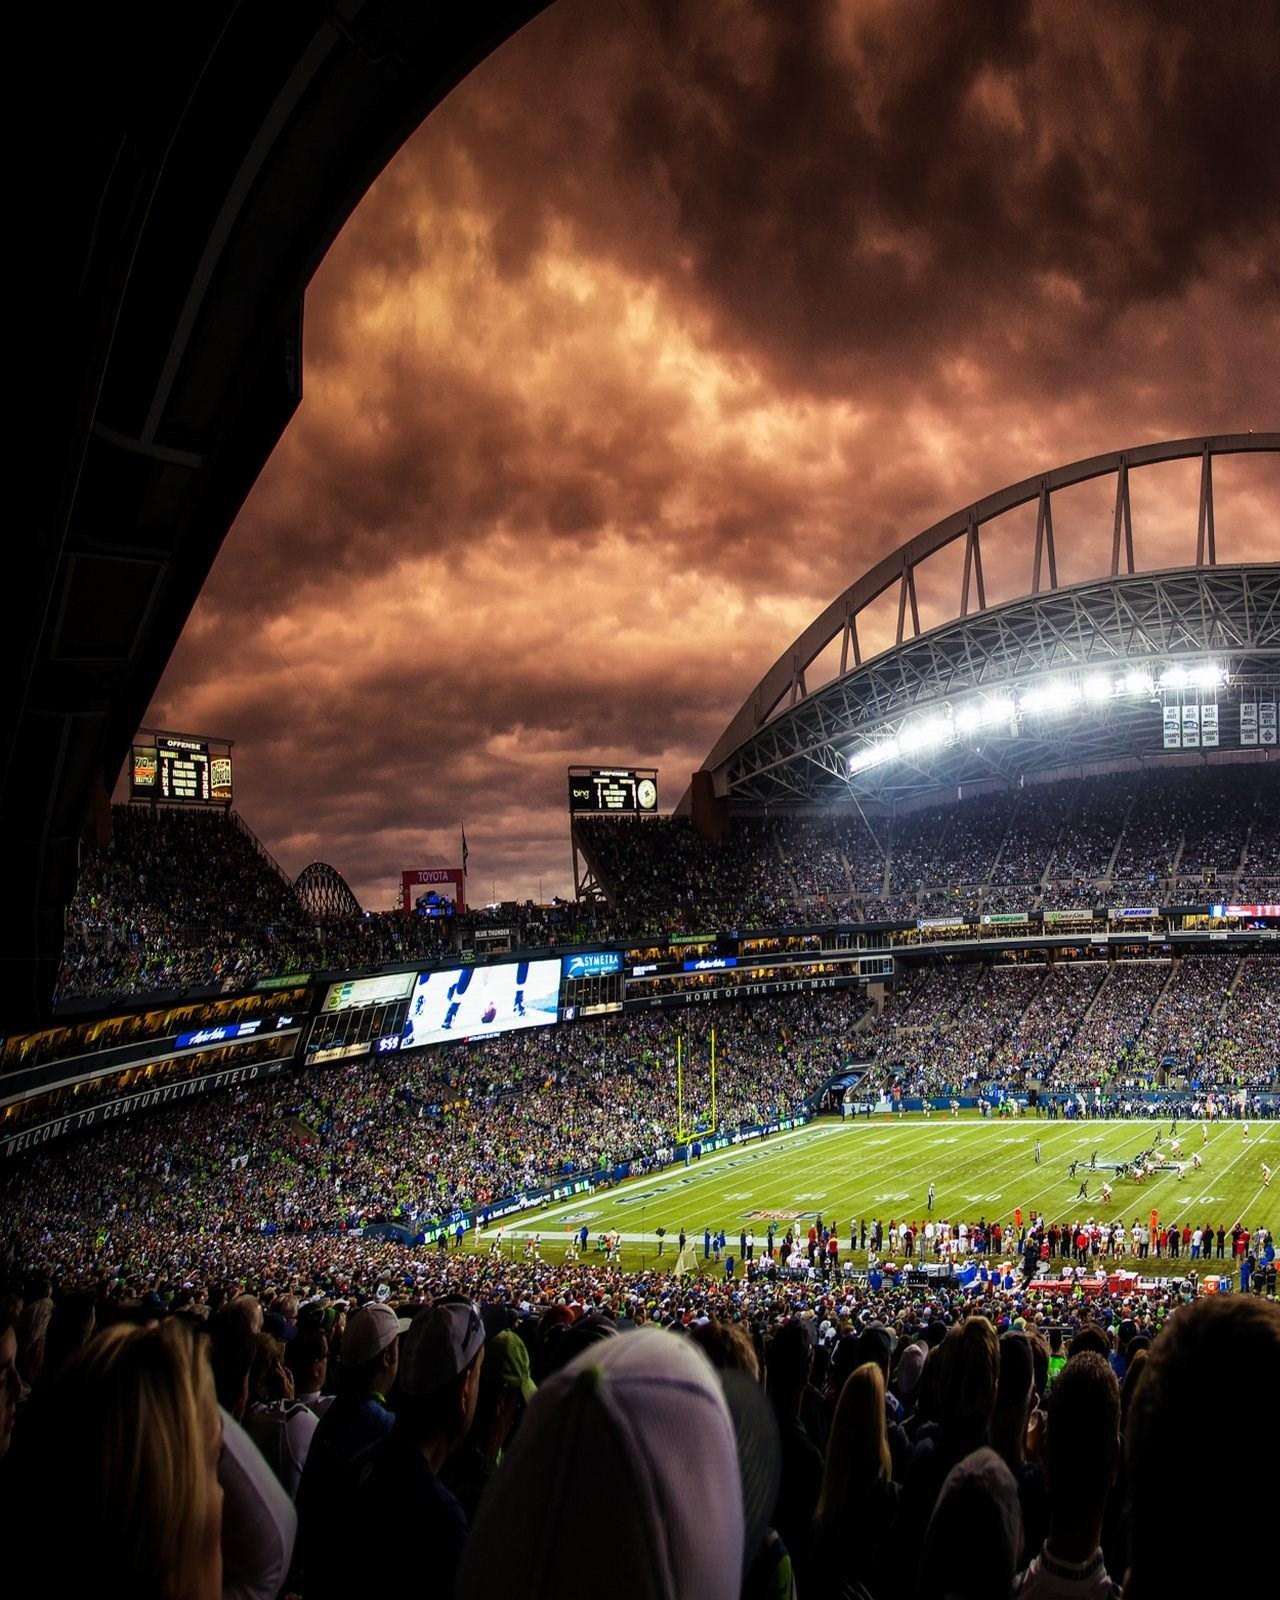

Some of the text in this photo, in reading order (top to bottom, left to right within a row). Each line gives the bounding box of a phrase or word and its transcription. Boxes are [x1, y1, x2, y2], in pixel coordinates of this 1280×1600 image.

[167, 740, 201, 750] OFFENSE
[573, 789, 590, 799] bing
[418, 871, 449, 882] TOYOTA
[584, 954, 618, 966] SYMETRA
[686, 978, 835, 1003] HOME OF THE 12TH MAN
[6, 1066, 259, 1157] WELCOME TO CENTURYLINK FIELD
[1208, 1282, 1215, 1290] G
